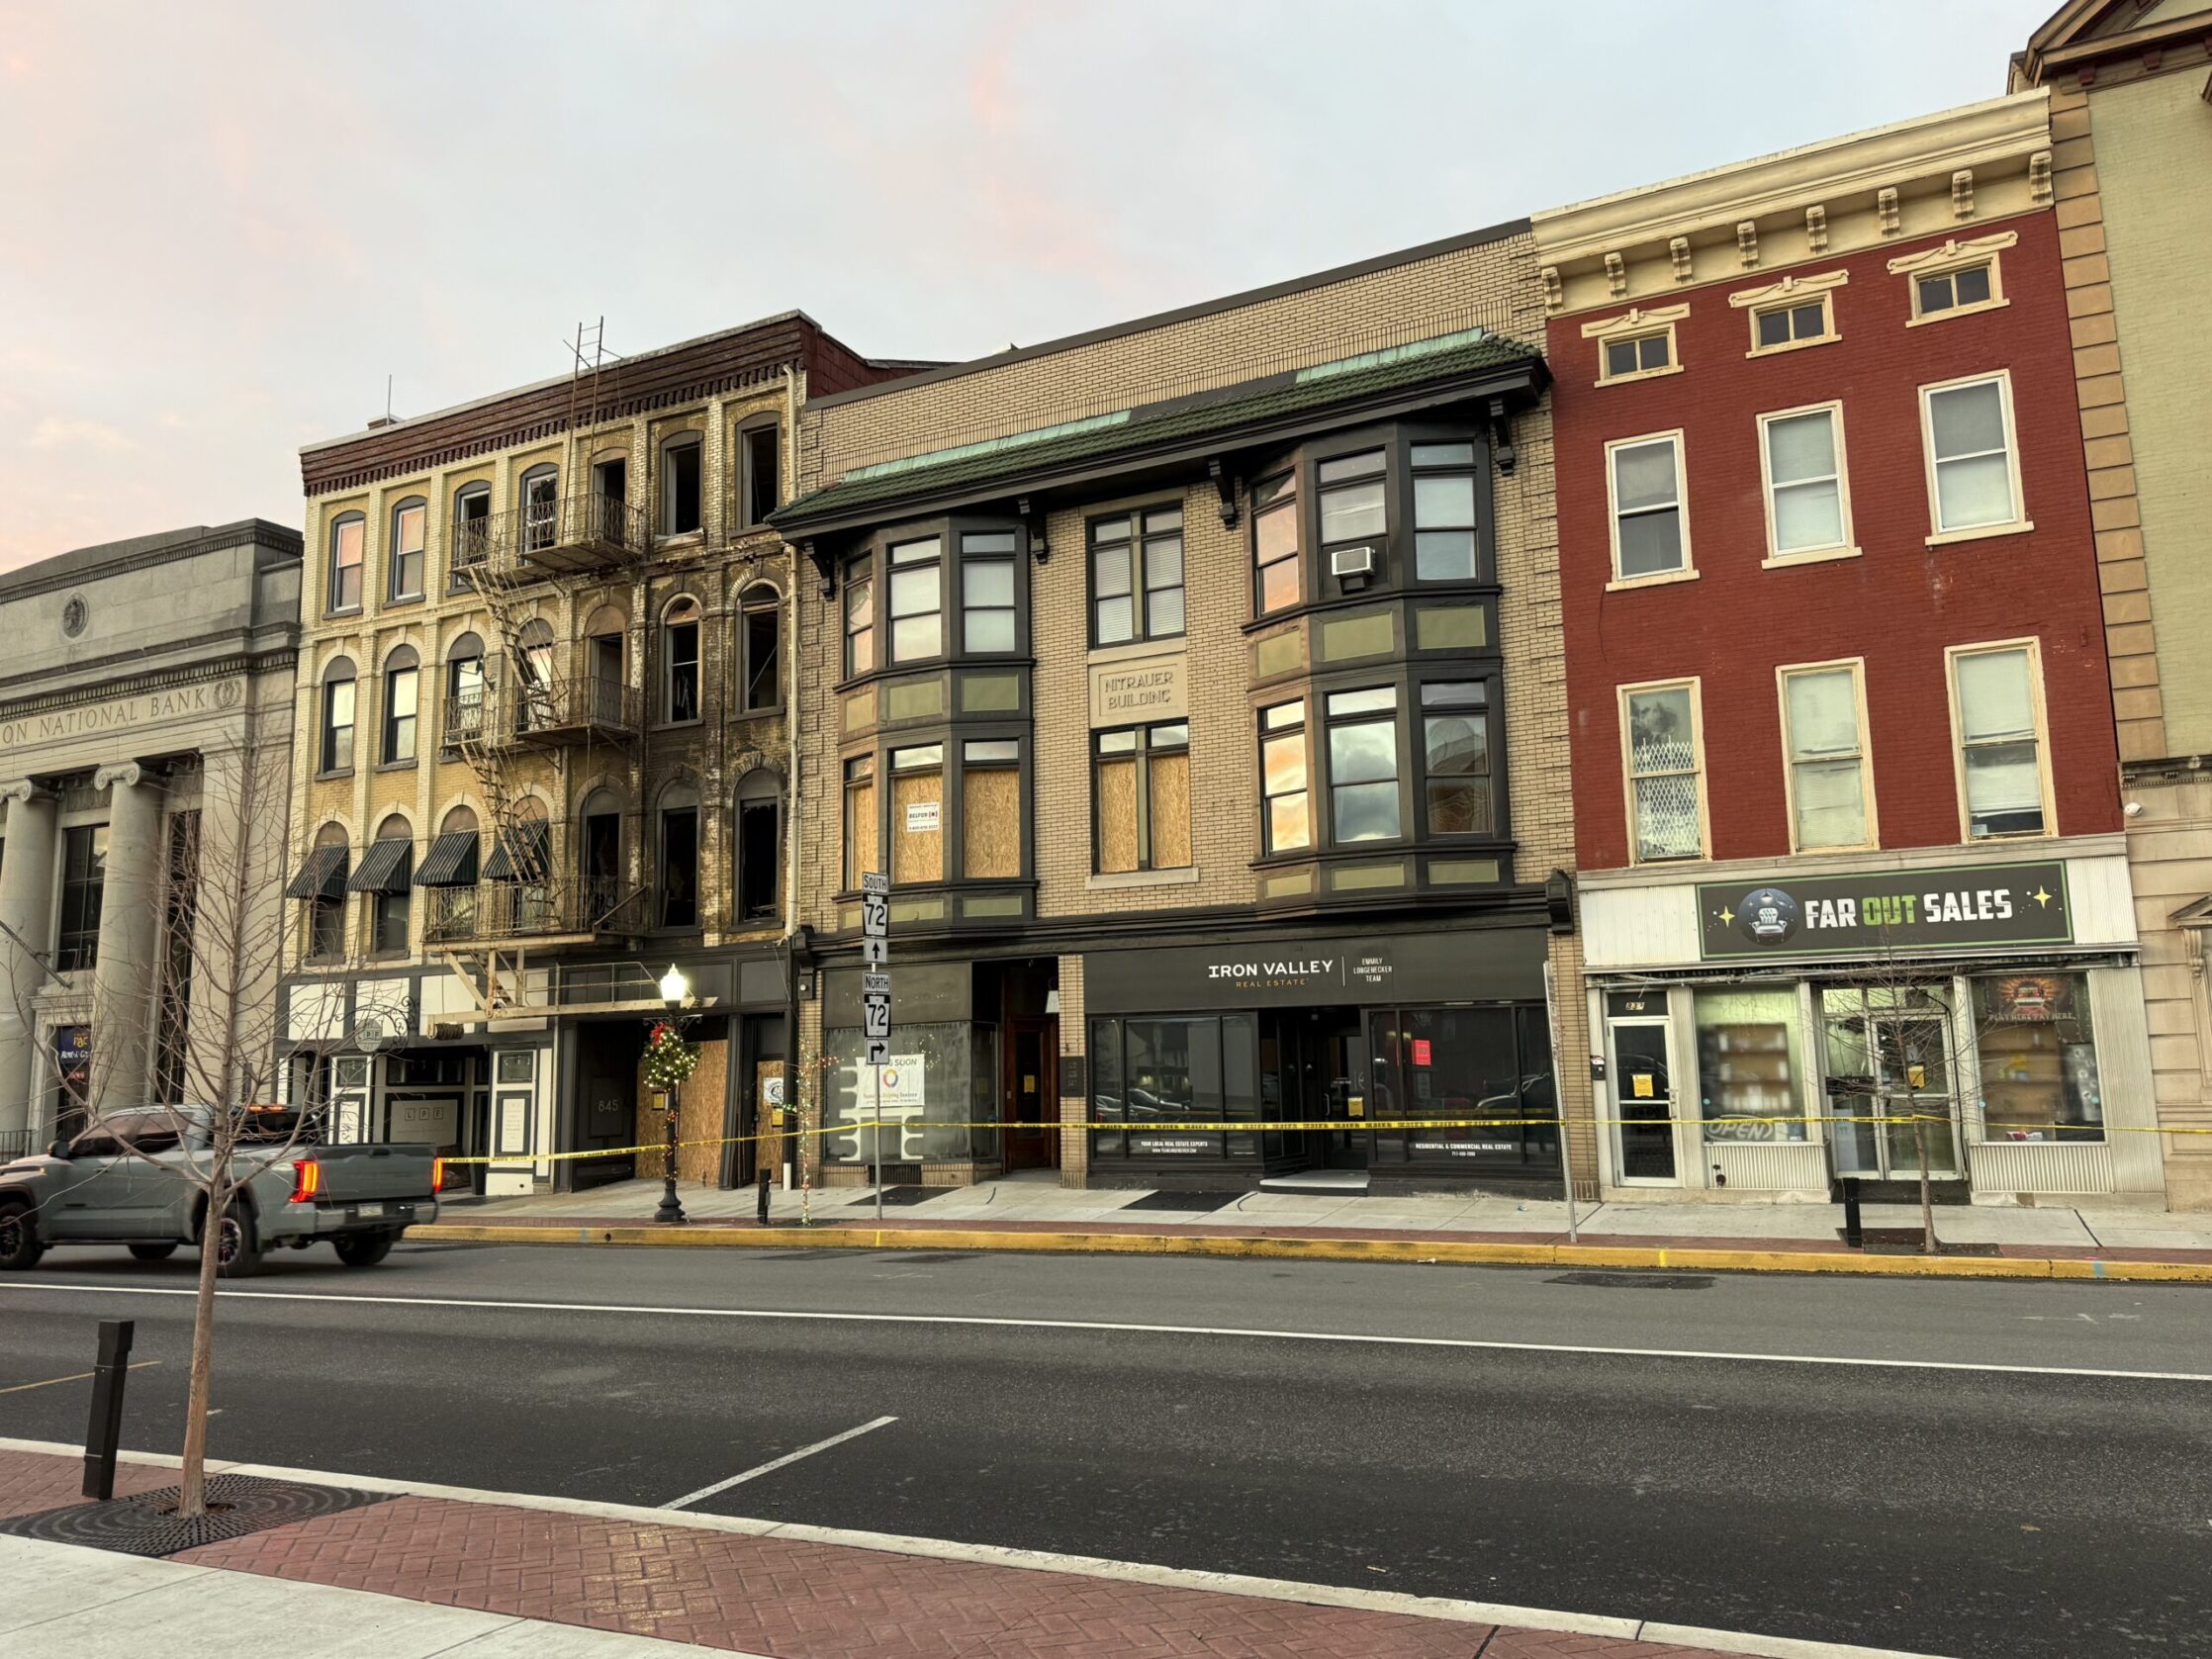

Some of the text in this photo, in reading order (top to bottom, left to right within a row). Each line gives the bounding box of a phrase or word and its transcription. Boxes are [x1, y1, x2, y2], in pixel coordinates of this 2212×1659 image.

[1104, 673, 1174, 692] NITRAUER
[1108, 689, 1171, 709] BUILDING
[39, 701, 138, 738] NATIONAL
[149, 688, 206, 717] BANK
[864, 875, 886, 889] SOUTH
[865, 903, 885, 926] 72
[1804, 888, 2013, 929] FAR OUT SALES
[1208, 960, 1334, 978] IRON VALLEY
[865, 975, 888, 989] NORTH
[868, 1003, 886, 1026] 72
[894, 1058, 917, 1066] SOON
[1707, 1118, 1764, 1140] OPEN
